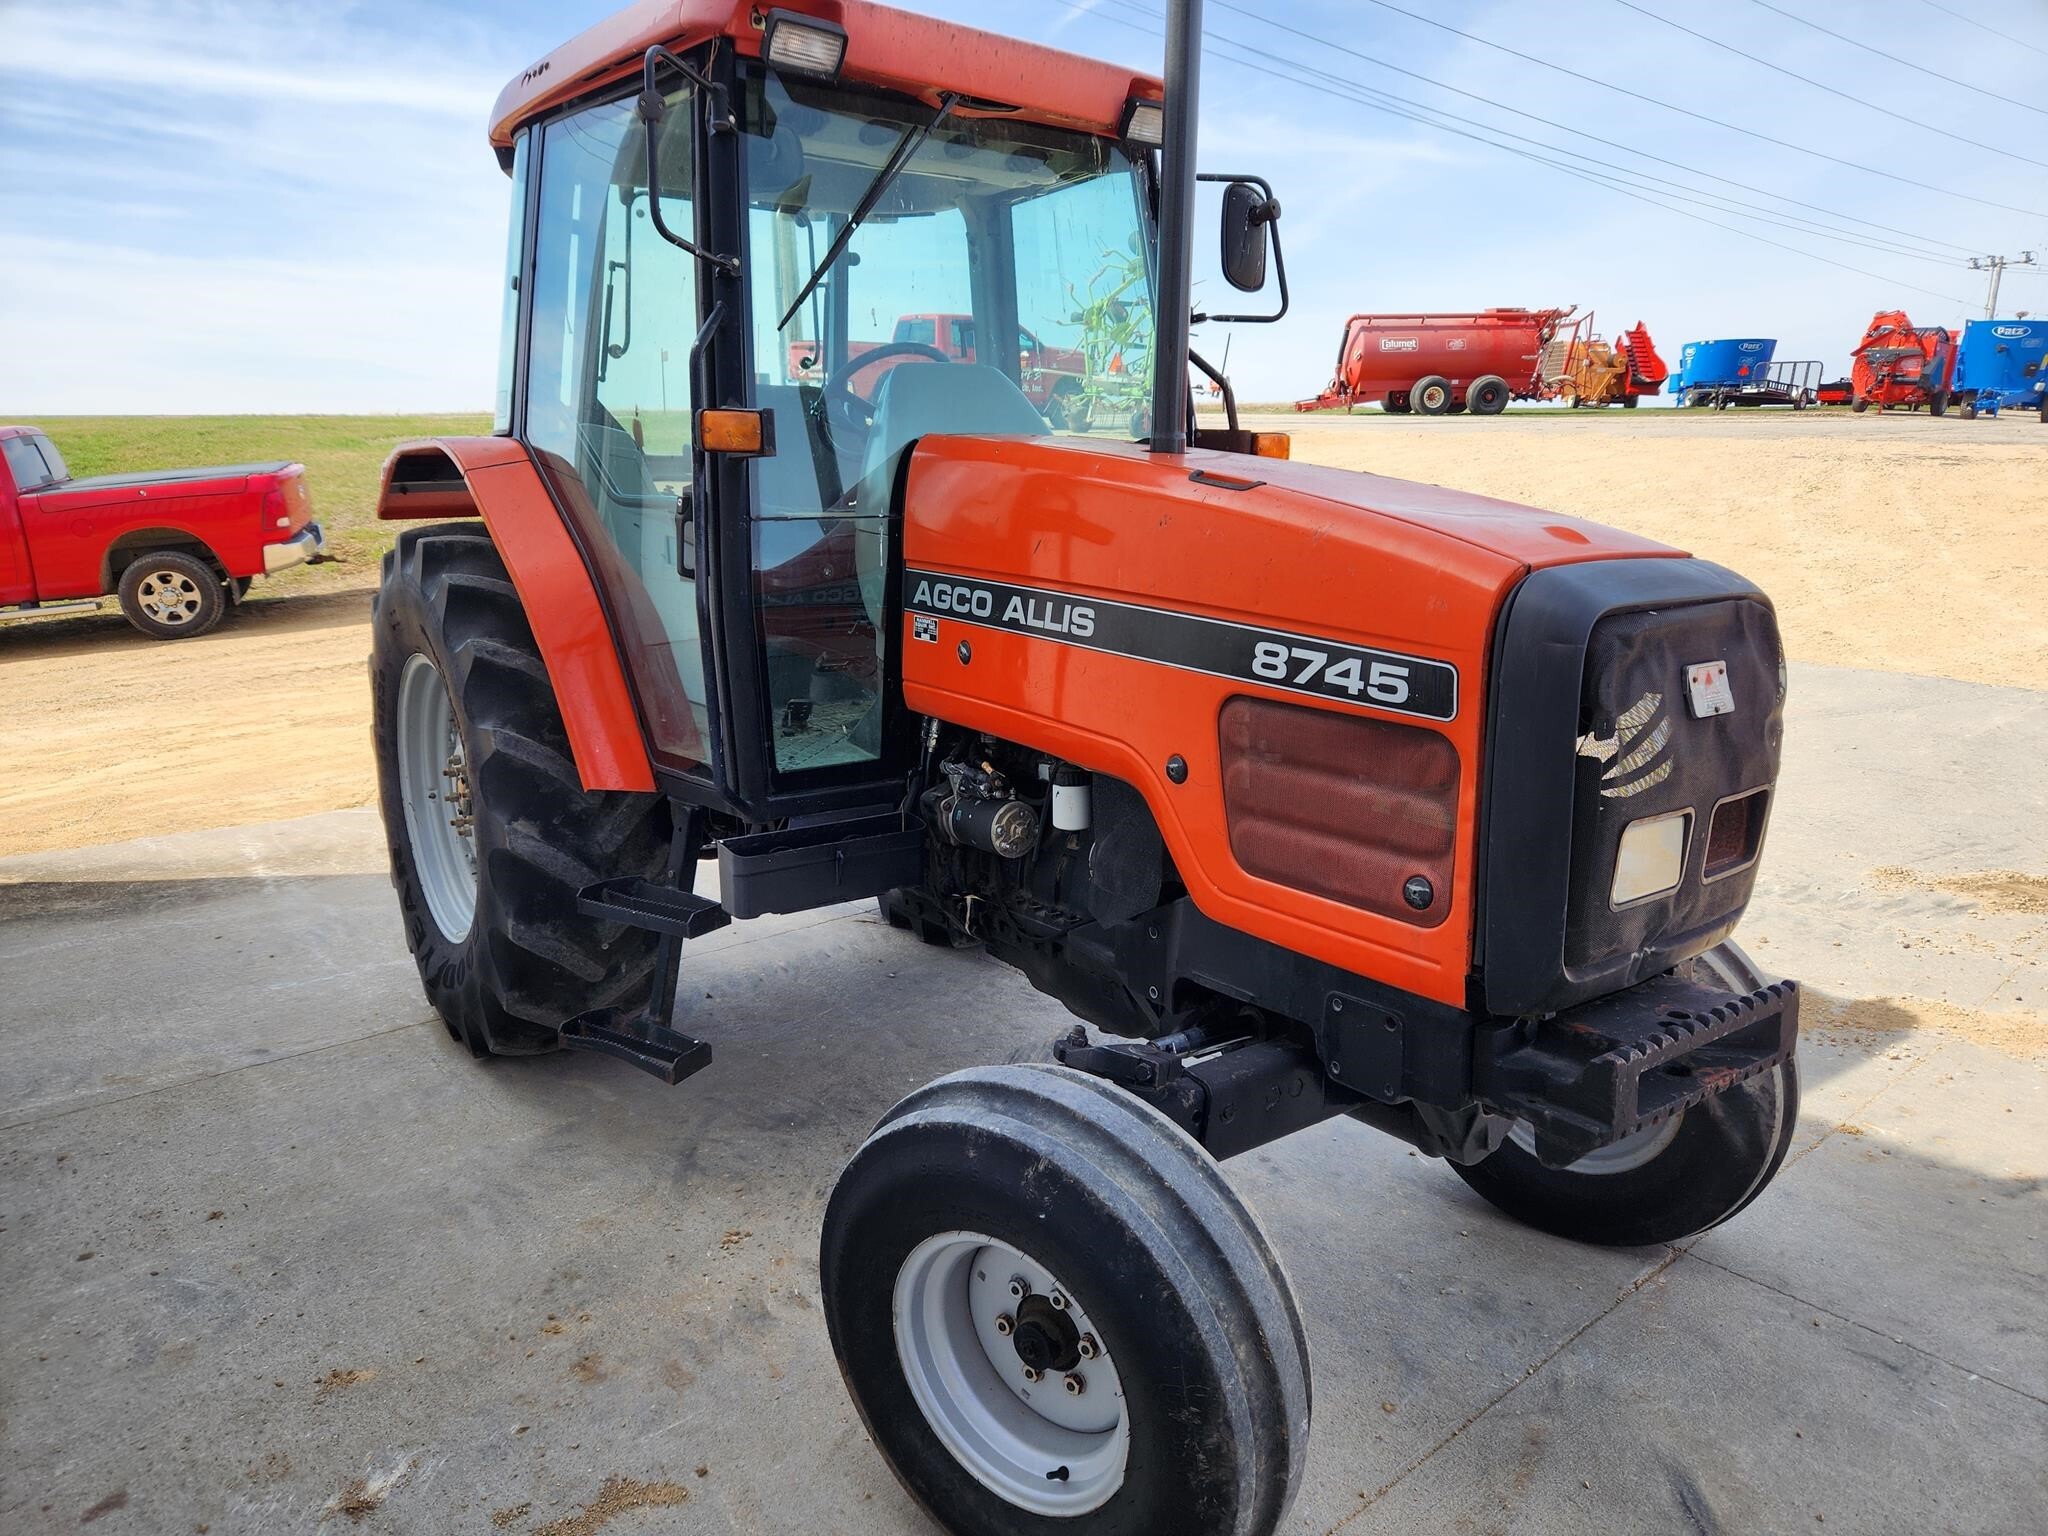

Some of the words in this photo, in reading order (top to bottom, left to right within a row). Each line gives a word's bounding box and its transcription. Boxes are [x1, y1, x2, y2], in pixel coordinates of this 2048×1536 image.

[1381, 339, 1417, 350] Calumet
[912, 580, 993, 619] AGCO
[1002, 595, 1095, 638] ALLIS
[1251, 641, 1410, 704] 8745
